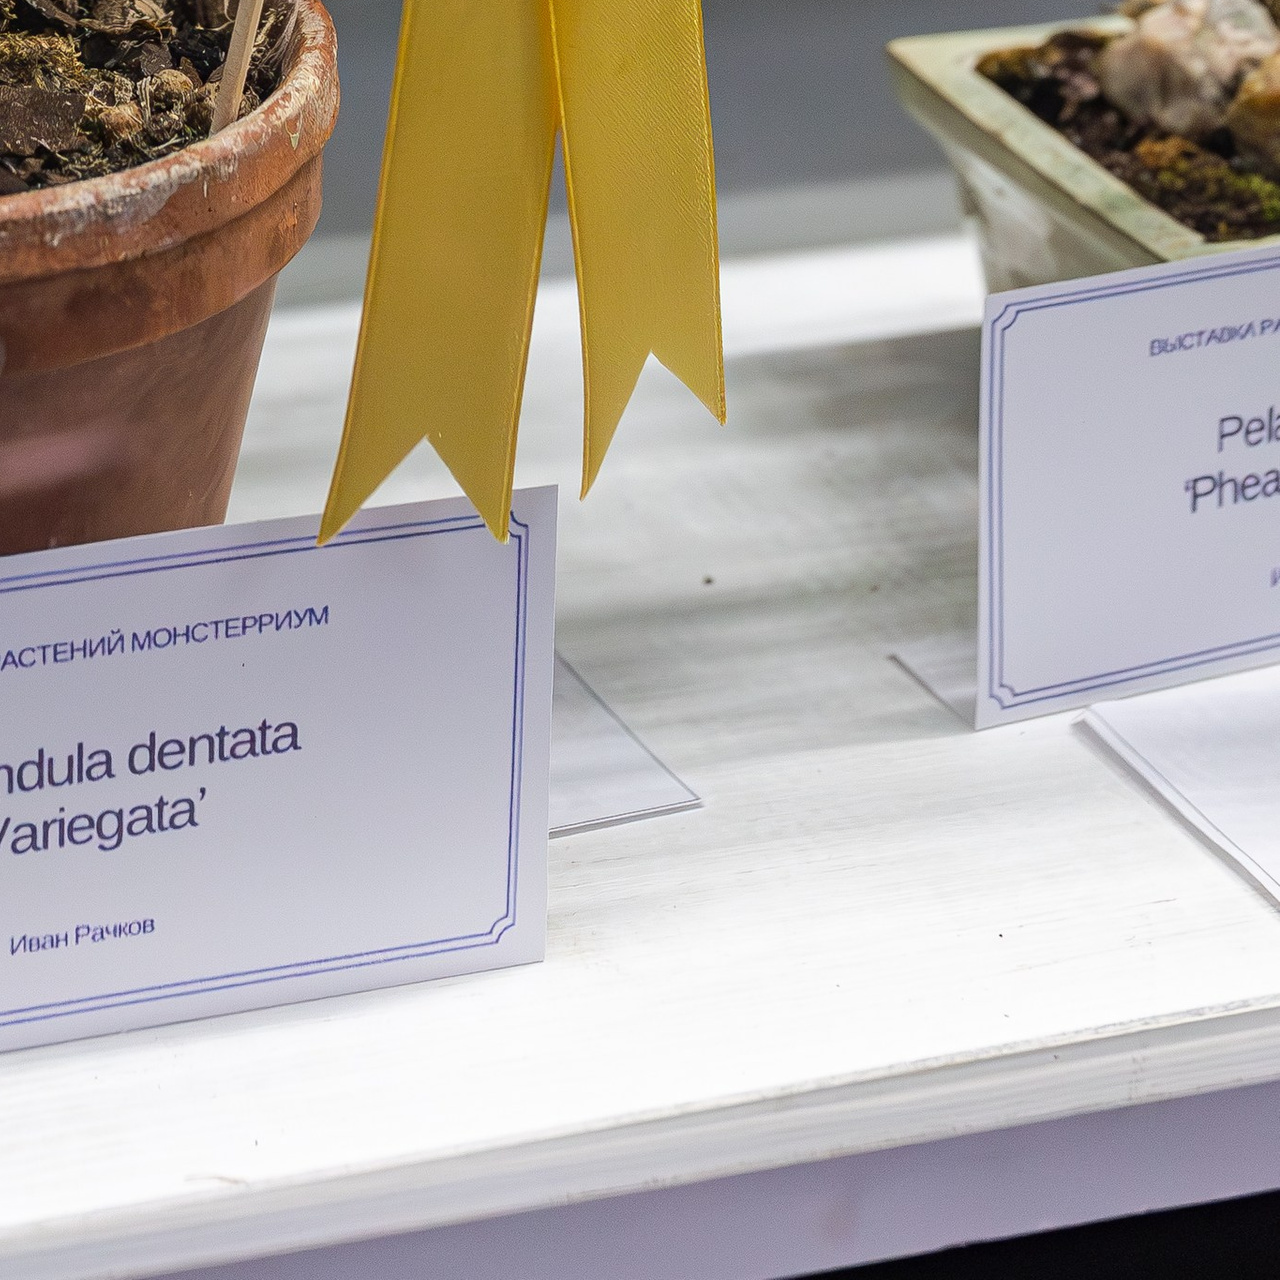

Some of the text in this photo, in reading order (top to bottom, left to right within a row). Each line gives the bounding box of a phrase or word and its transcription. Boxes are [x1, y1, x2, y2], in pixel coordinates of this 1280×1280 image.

[1149, 320, 1256, 357] ВЫСТАВКА
[131, 605, 330, 652] МОНСТЕРРИУМ
[127, 718, 302, 775] dentata
[9, 916, 156, 956] Иван Рачков
